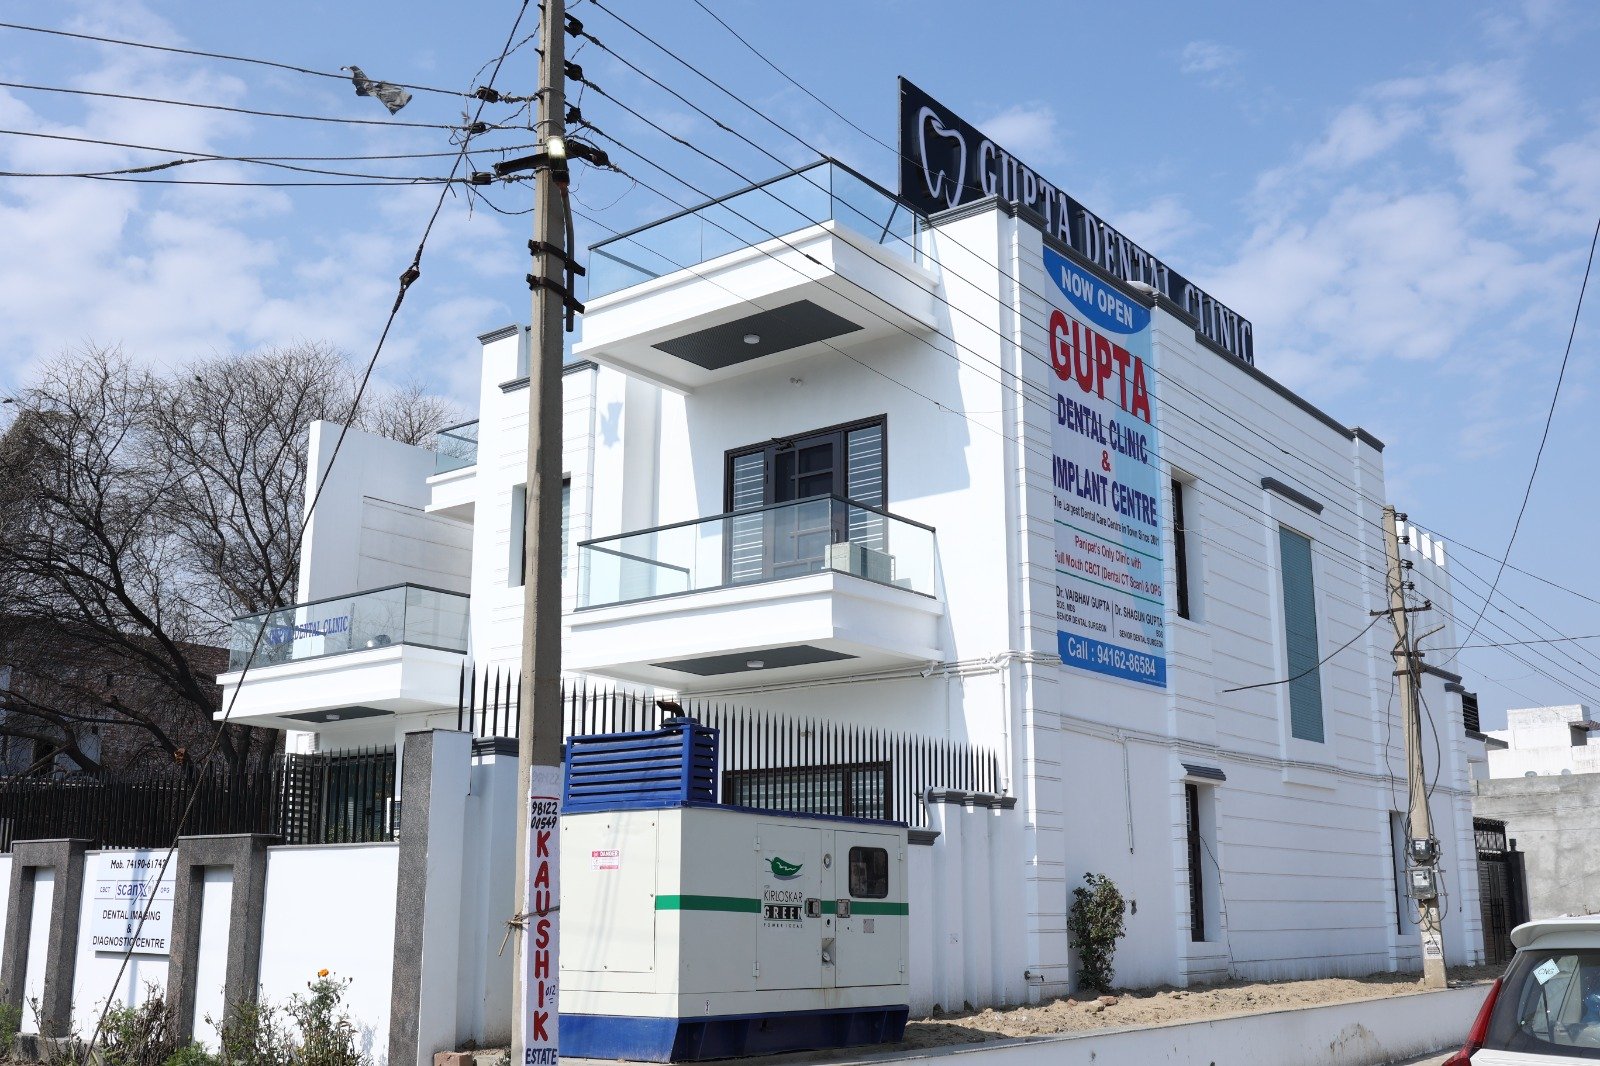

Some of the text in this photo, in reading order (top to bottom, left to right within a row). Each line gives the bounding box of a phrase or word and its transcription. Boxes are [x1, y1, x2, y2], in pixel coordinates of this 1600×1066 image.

[981, 140, 1253, 365] GUPTA DENTAL CLINIC
[1061, 266, 1133, 329] NOW OPEN
[1050, 309, 1151, 425] GUPTA
[1057, 393, 1148, 465] DENTAL CLINIC
[1101, 449, 1111, 472] &
[1052, 454, 1158, 527] IMPLANT CENTRE
[1063, 500, 1080, 516] Largest
[1080, 506, 1096, 522] Dental
[1096, 513, 1107, 526] Care
[1107, 517, 1121, 532] Centre
[1121, 523, 1127, 535] in
[1126, 525, 1138, 538] Town
[1138, 529, 1150, 543] Since
[1074, 534, 1142, 570] Panipat's Only Clinic with
[1065, 553, 1084, 571] Mouth
[1084, 560, 1100, 577] CBCT
[1101, 565, 1121, 584] (Dental
[1120, 573, 1129, 586] CT
[1129, 576, 1145, 592] Scan)
[1149, 582, 1162, 597] OPG
[1056, 585, 1111, 612] Dr. VAIBHAV GUPTA
[323, 615, 349, 635] CLINIC
[1072, 615, 1088, 628] DENTAL
[1114, 603, 1164, 629] Dr. SHAGUN GUPTA
[1132, 633, 1147, 644] DENTAL
[1068, 637, 1088, 660] Call
[1097, 644, 1156, 676] 94162-86584
[532, 801, 558, 816] 98122
[530, 815, 558, 829] 00549
[110, 859, 125, 869] Mob.
[764, 890, 803, 903] KIRLOSKAR
[102, 909, 161, 921] DENTAL IMAGING
[126, 923, 132, 934] &
[534, 829, 551, 1042] KAUSHIK
[92, 935, 165, 949] DIAGNOSTIC CENTRE
[526, 1048, 558, 1065] ESTATE
